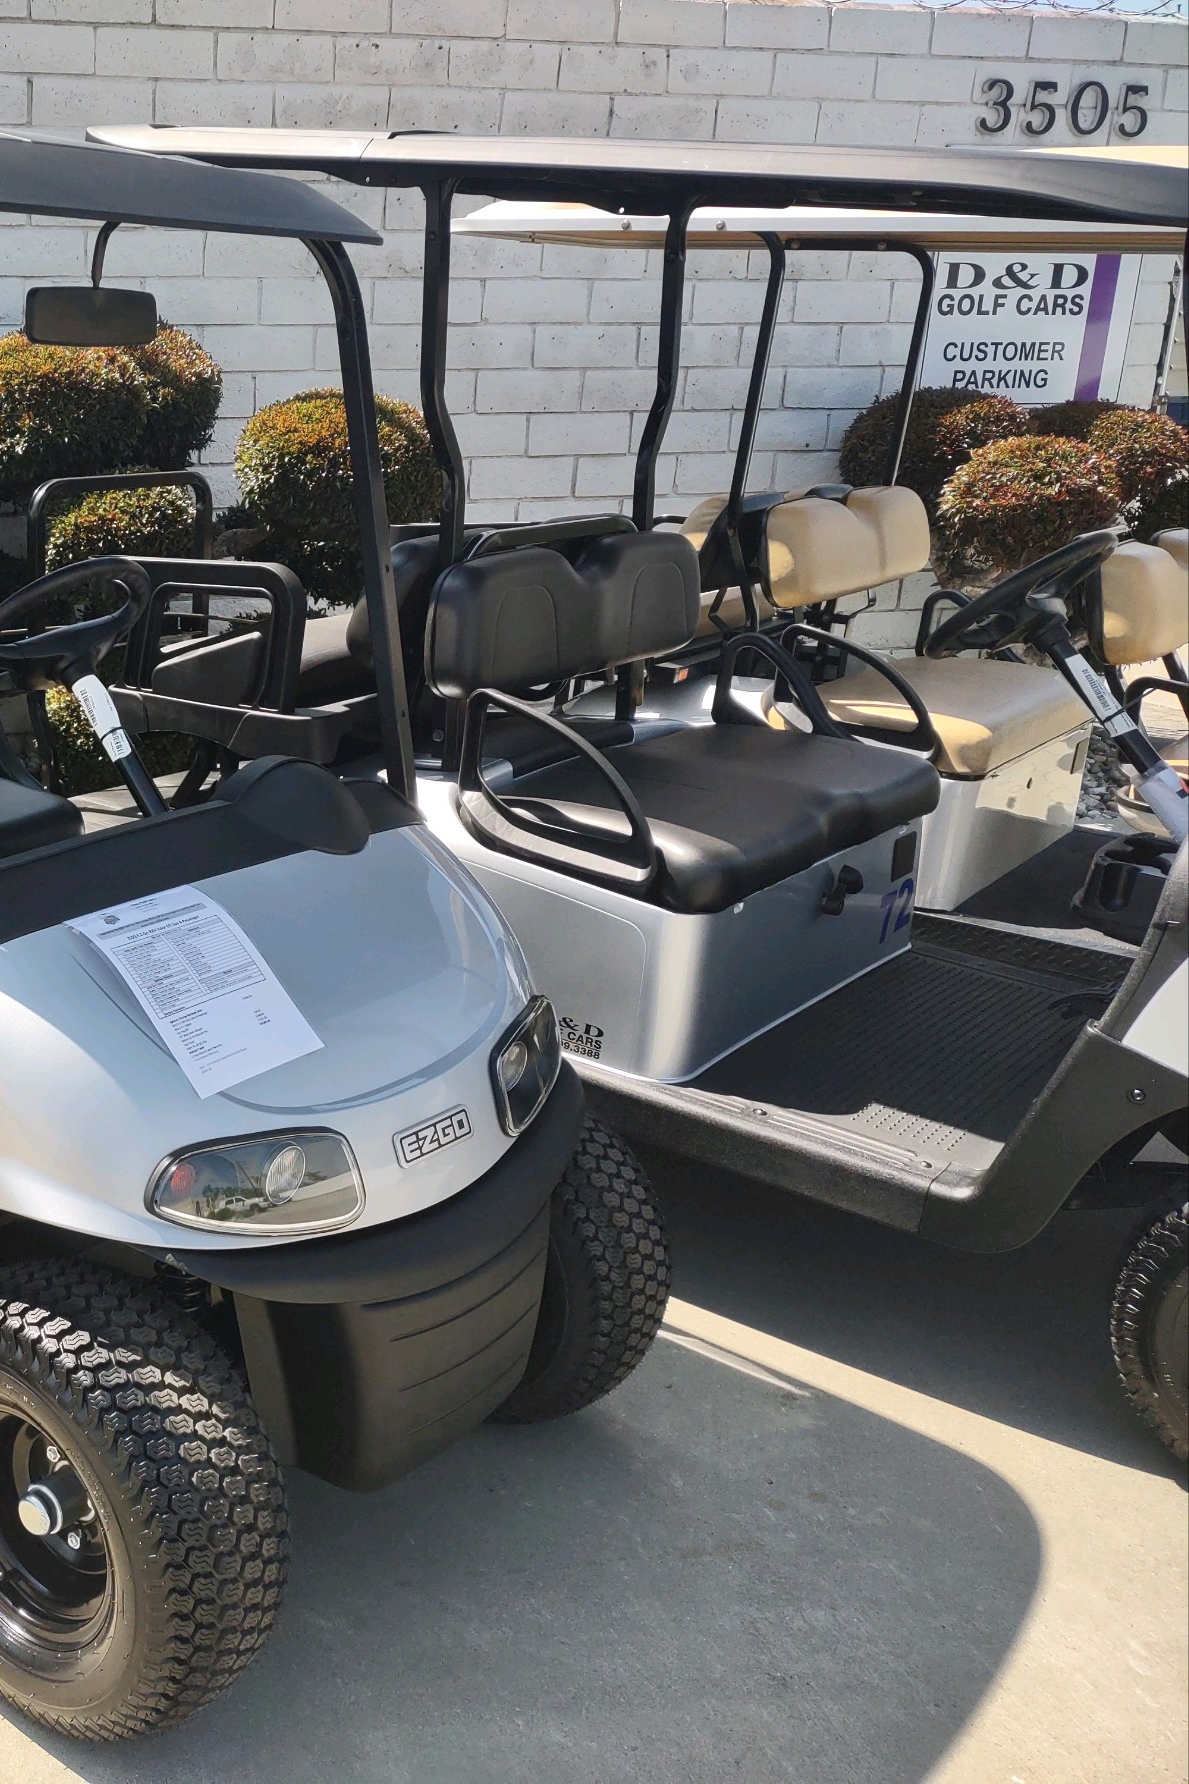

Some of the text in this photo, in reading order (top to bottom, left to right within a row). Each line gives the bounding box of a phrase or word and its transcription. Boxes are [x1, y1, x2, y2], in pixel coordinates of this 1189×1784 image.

[977, 78, 1149, 138] 3505
[940, 261, 1089, 290] D&D
[937, 293, 1085, 316] GOLF CARS
[942, 341, 1066, 362] CUSTOMER
[951, 369, 1049, 389] PARKING
[879, 877, 914, 944] 72
[561, 1040, 600, 1060] 9.3388
[567, 1031, 602, 1050] CARS
[400, 1109, 471, 1163] EZGO
